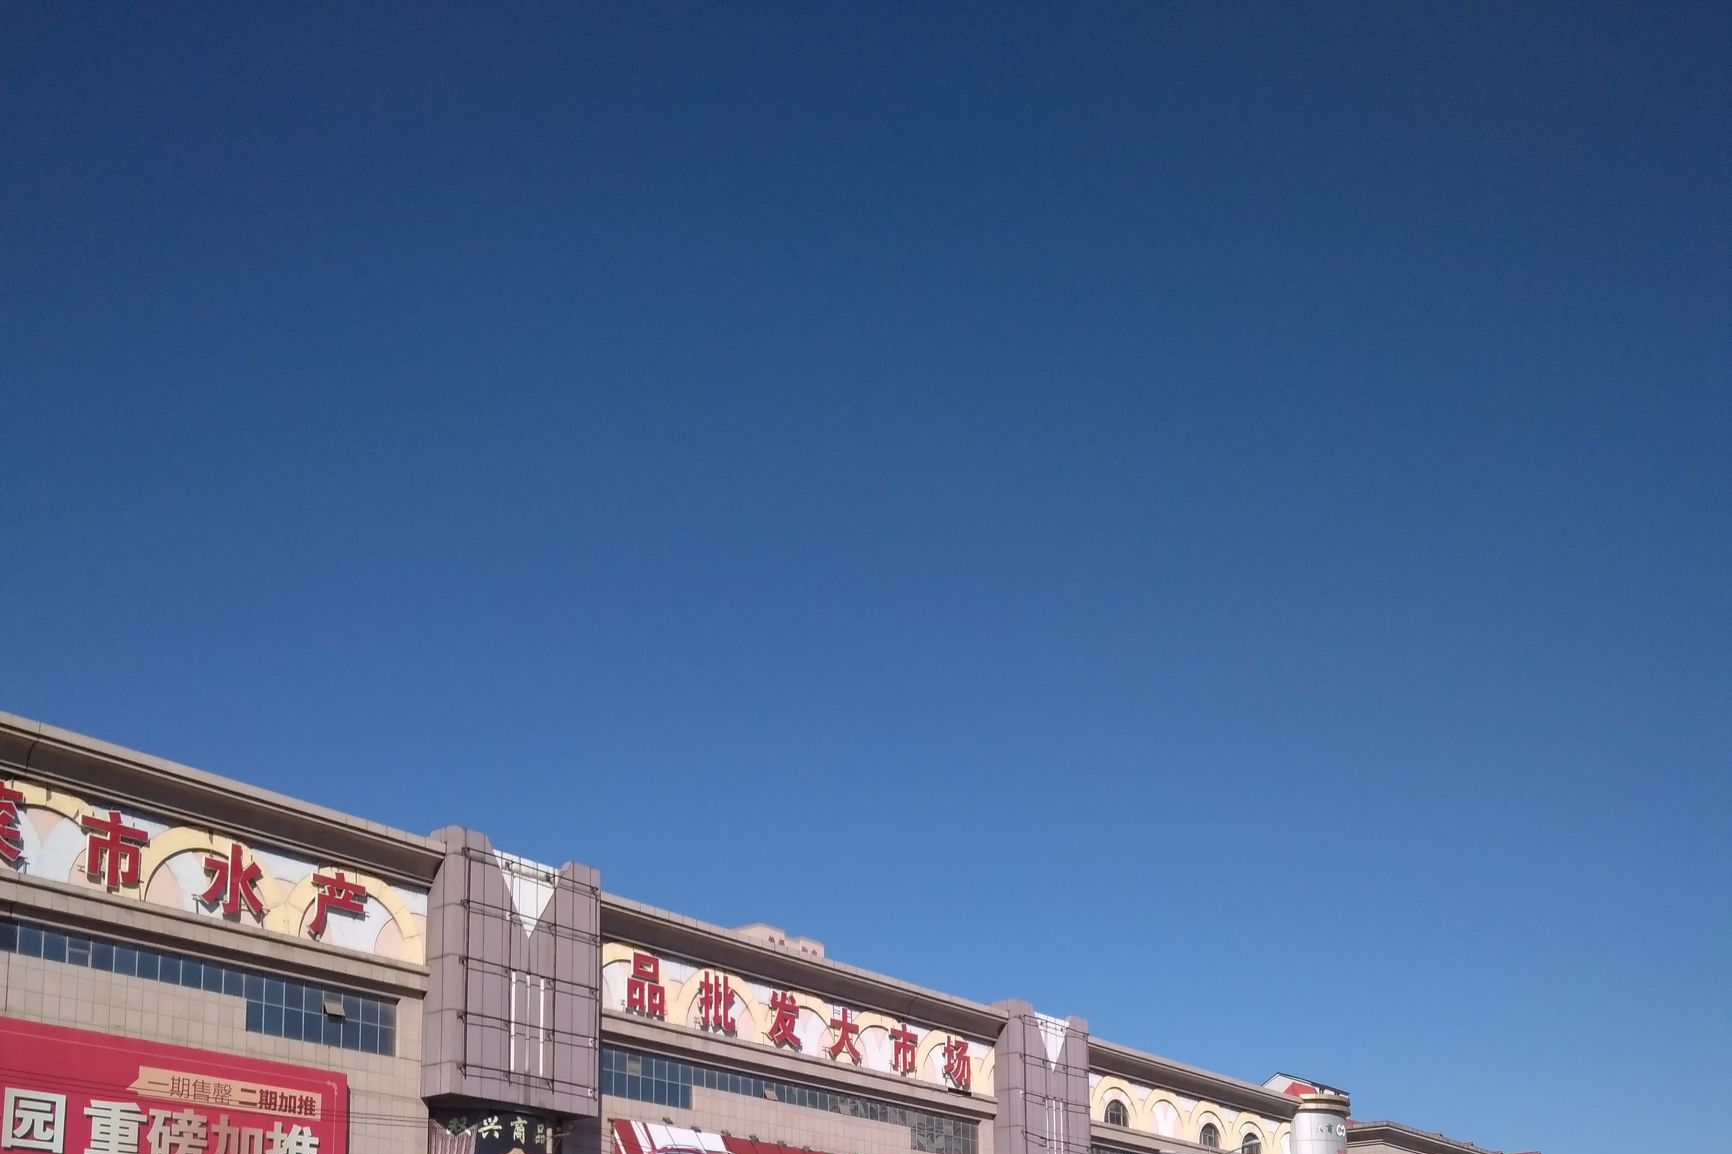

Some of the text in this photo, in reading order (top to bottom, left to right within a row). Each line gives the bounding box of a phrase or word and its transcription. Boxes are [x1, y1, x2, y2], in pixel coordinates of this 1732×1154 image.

[626, 951, 972, 1091] 品批发大市场
[1, 1087, 67, 1154] 园
[148, 1075, 317, 1117] 一期售罄 二期加推
